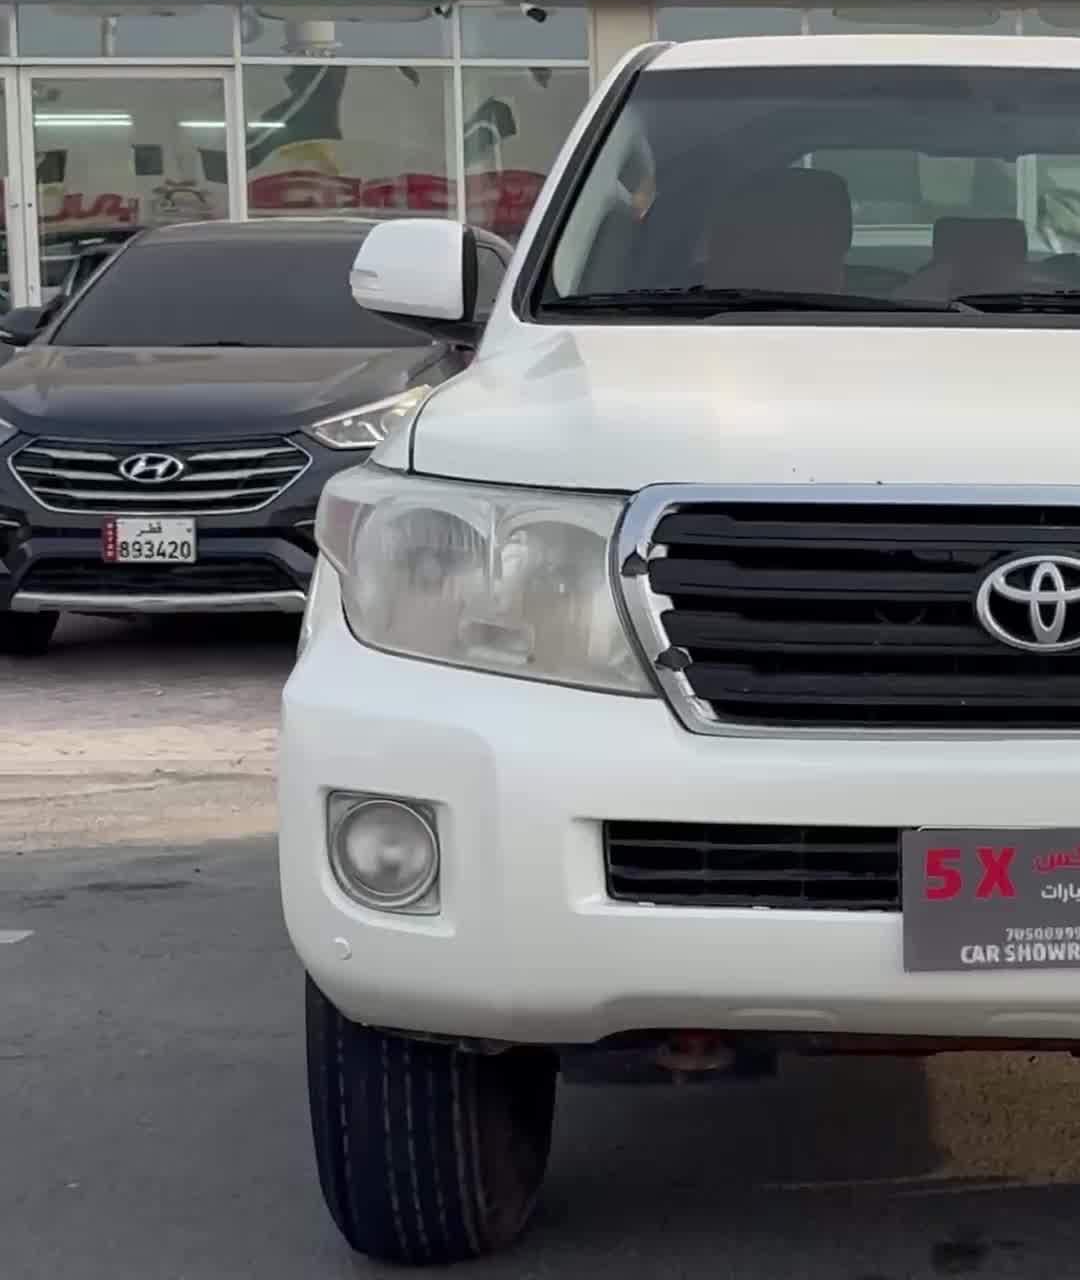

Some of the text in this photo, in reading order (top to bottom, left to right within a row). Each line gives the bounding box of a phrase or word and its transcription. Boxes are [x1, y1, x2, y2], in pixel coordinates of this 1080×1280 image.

[119, 540, 192, 560] 893420
[923, 846, 1017, 902] 5 X
[960, 944, 1000, 964] CAR
